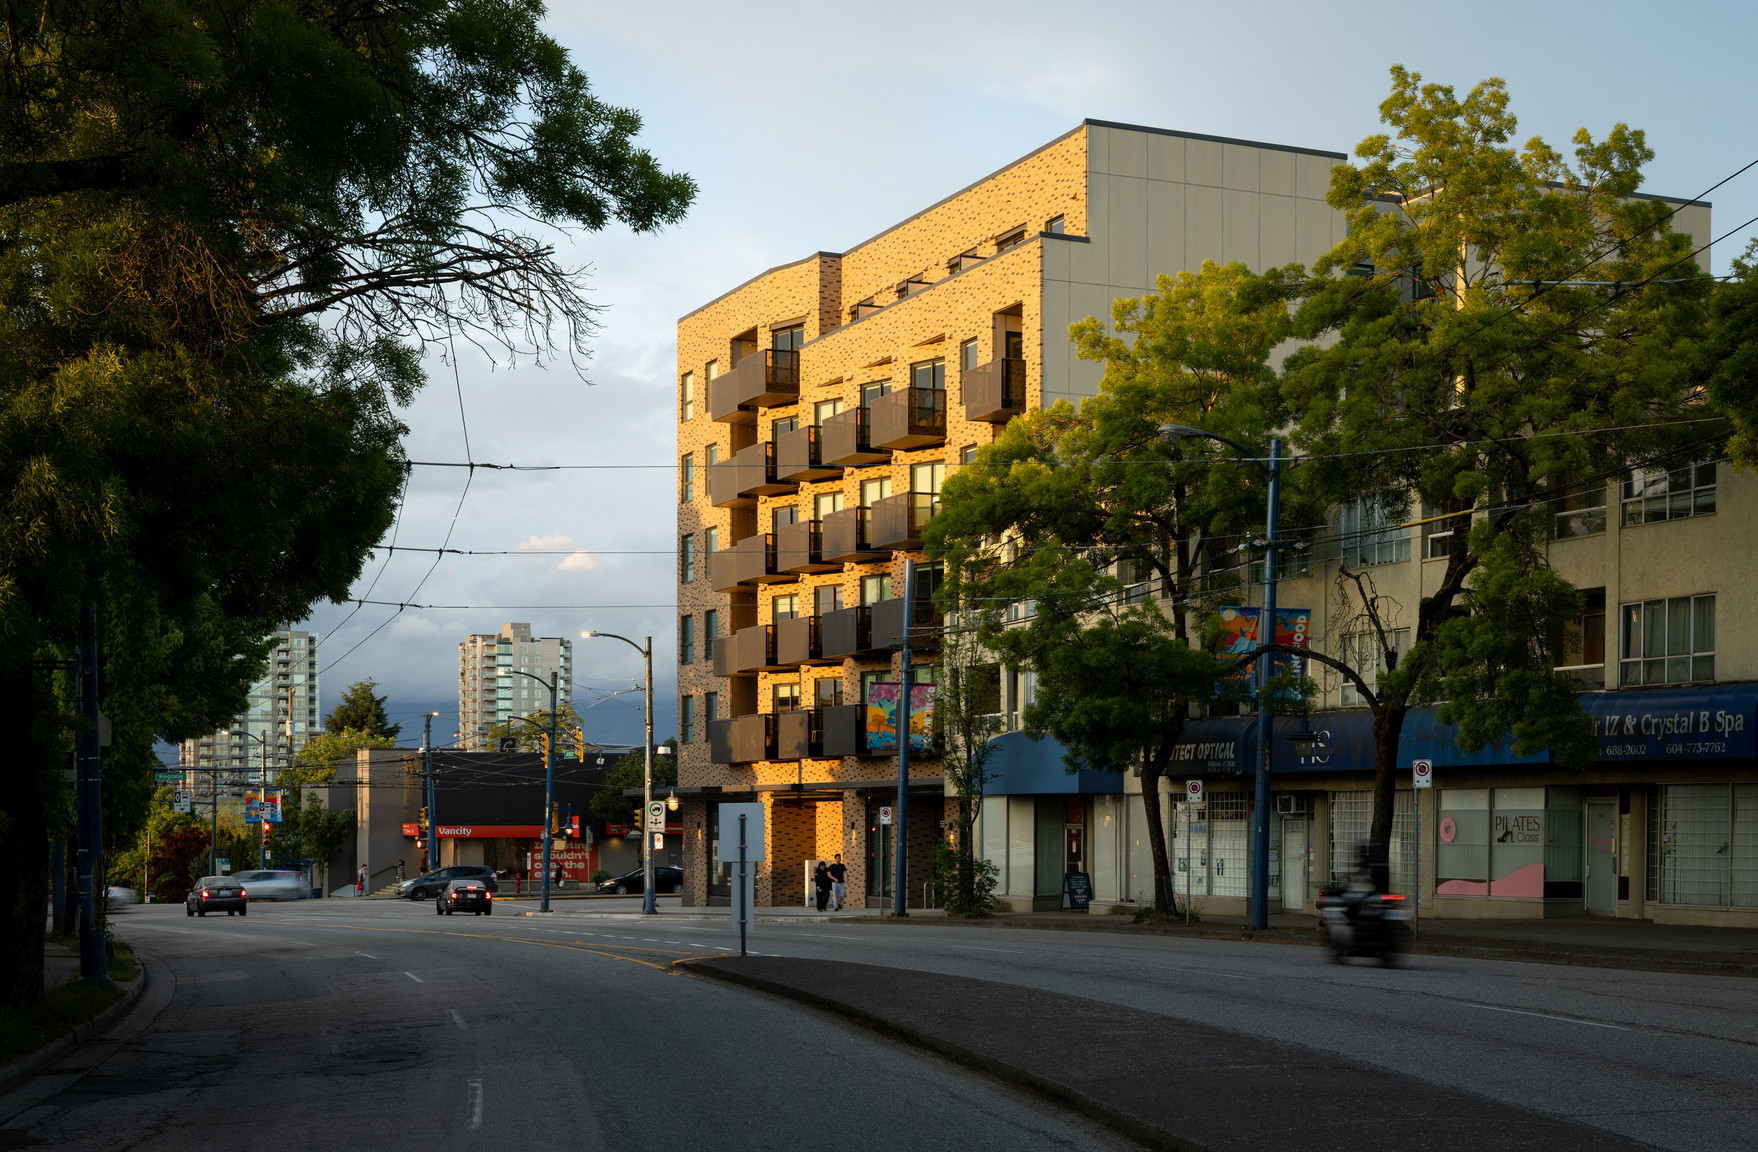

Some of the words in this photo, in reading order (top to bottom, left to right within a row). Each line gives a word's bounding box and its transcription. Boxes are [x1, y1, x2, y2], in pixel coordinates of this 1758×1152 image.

[1605, 715, 1620, 736] IZ
[1623, 714, 1637, 736] &
[1641, 711, 1695, 741] Crystal
[1699, 711, 1711, 733] B
[1714, 710, 1745, 738] Spa
[1197, 741, 1236, 761] OPTICAL
[1666, 741, 1727, 754] 604-773-7762
[438, 826, 472, 837] Vancity
[1516, 831, 1539, 843] Class
[534, 851, 591, 860] souldn't
[564, 861, 585, 869] the
